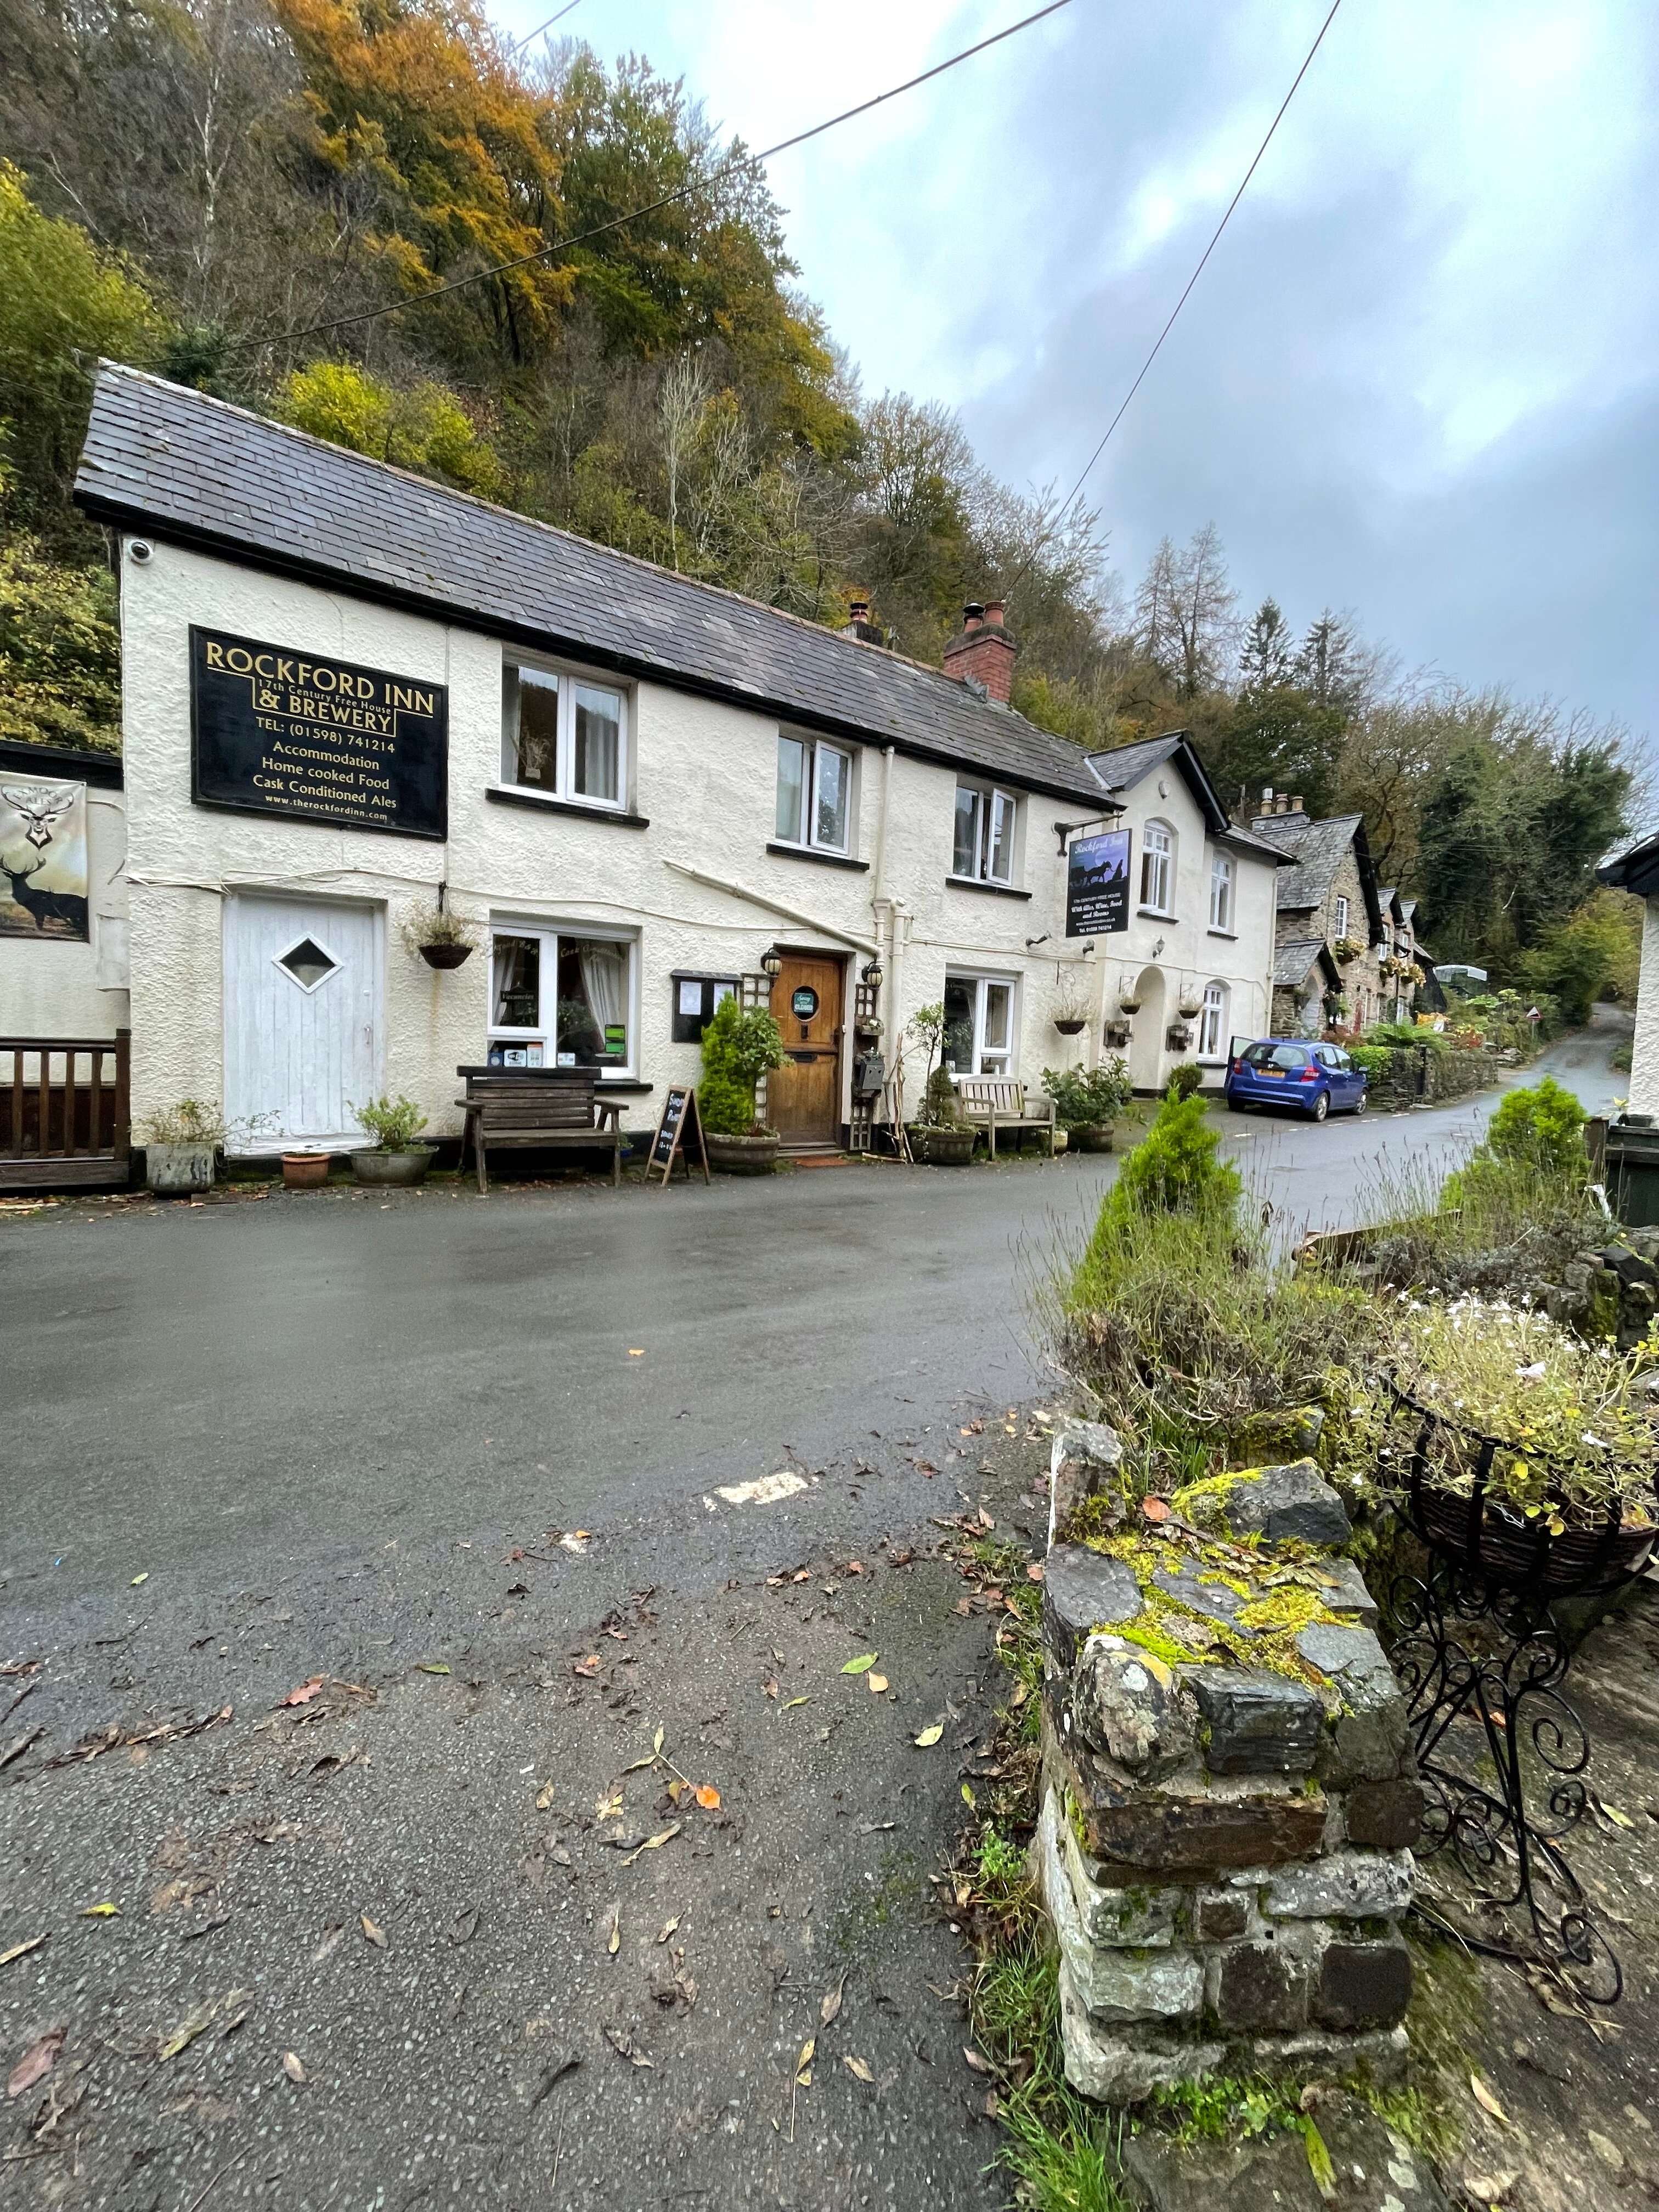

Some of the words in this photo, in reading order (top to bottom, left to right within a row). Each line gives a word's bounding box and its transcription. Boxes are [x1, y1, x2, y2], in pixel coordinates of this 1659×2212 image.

[206, 641, 375, 699] ROCKFORD
[385, 683, 434, 714] INN
[258, 679, 284, 691] 17th
[289, 685, 331, 702] Century
[335, 695, 357, 707] Free
[361, 700, 391, 715] House
[259, 689, 280, 709] &
[290, 697, 392, 732] BREWERY
[256, 716, 285, 733] TEL:
[290, 723, 342, 745] (01598)
[347, 735, 396, 754] 741214
[273, 741, 380, 770] Accommodation
[262, 757, 304, 775] Home
[308, 765, 354, 785] cooked
[359, 774, 390, 790] Food
[253, 775, 284, 791] Cask
[289, 781, 366, 804] Conditioned
[371, 794, 397, 809] Ales
[265, 795, 388, 821] www.therockfordinn.com
[1075, 838, 1108, 854] Rockford
